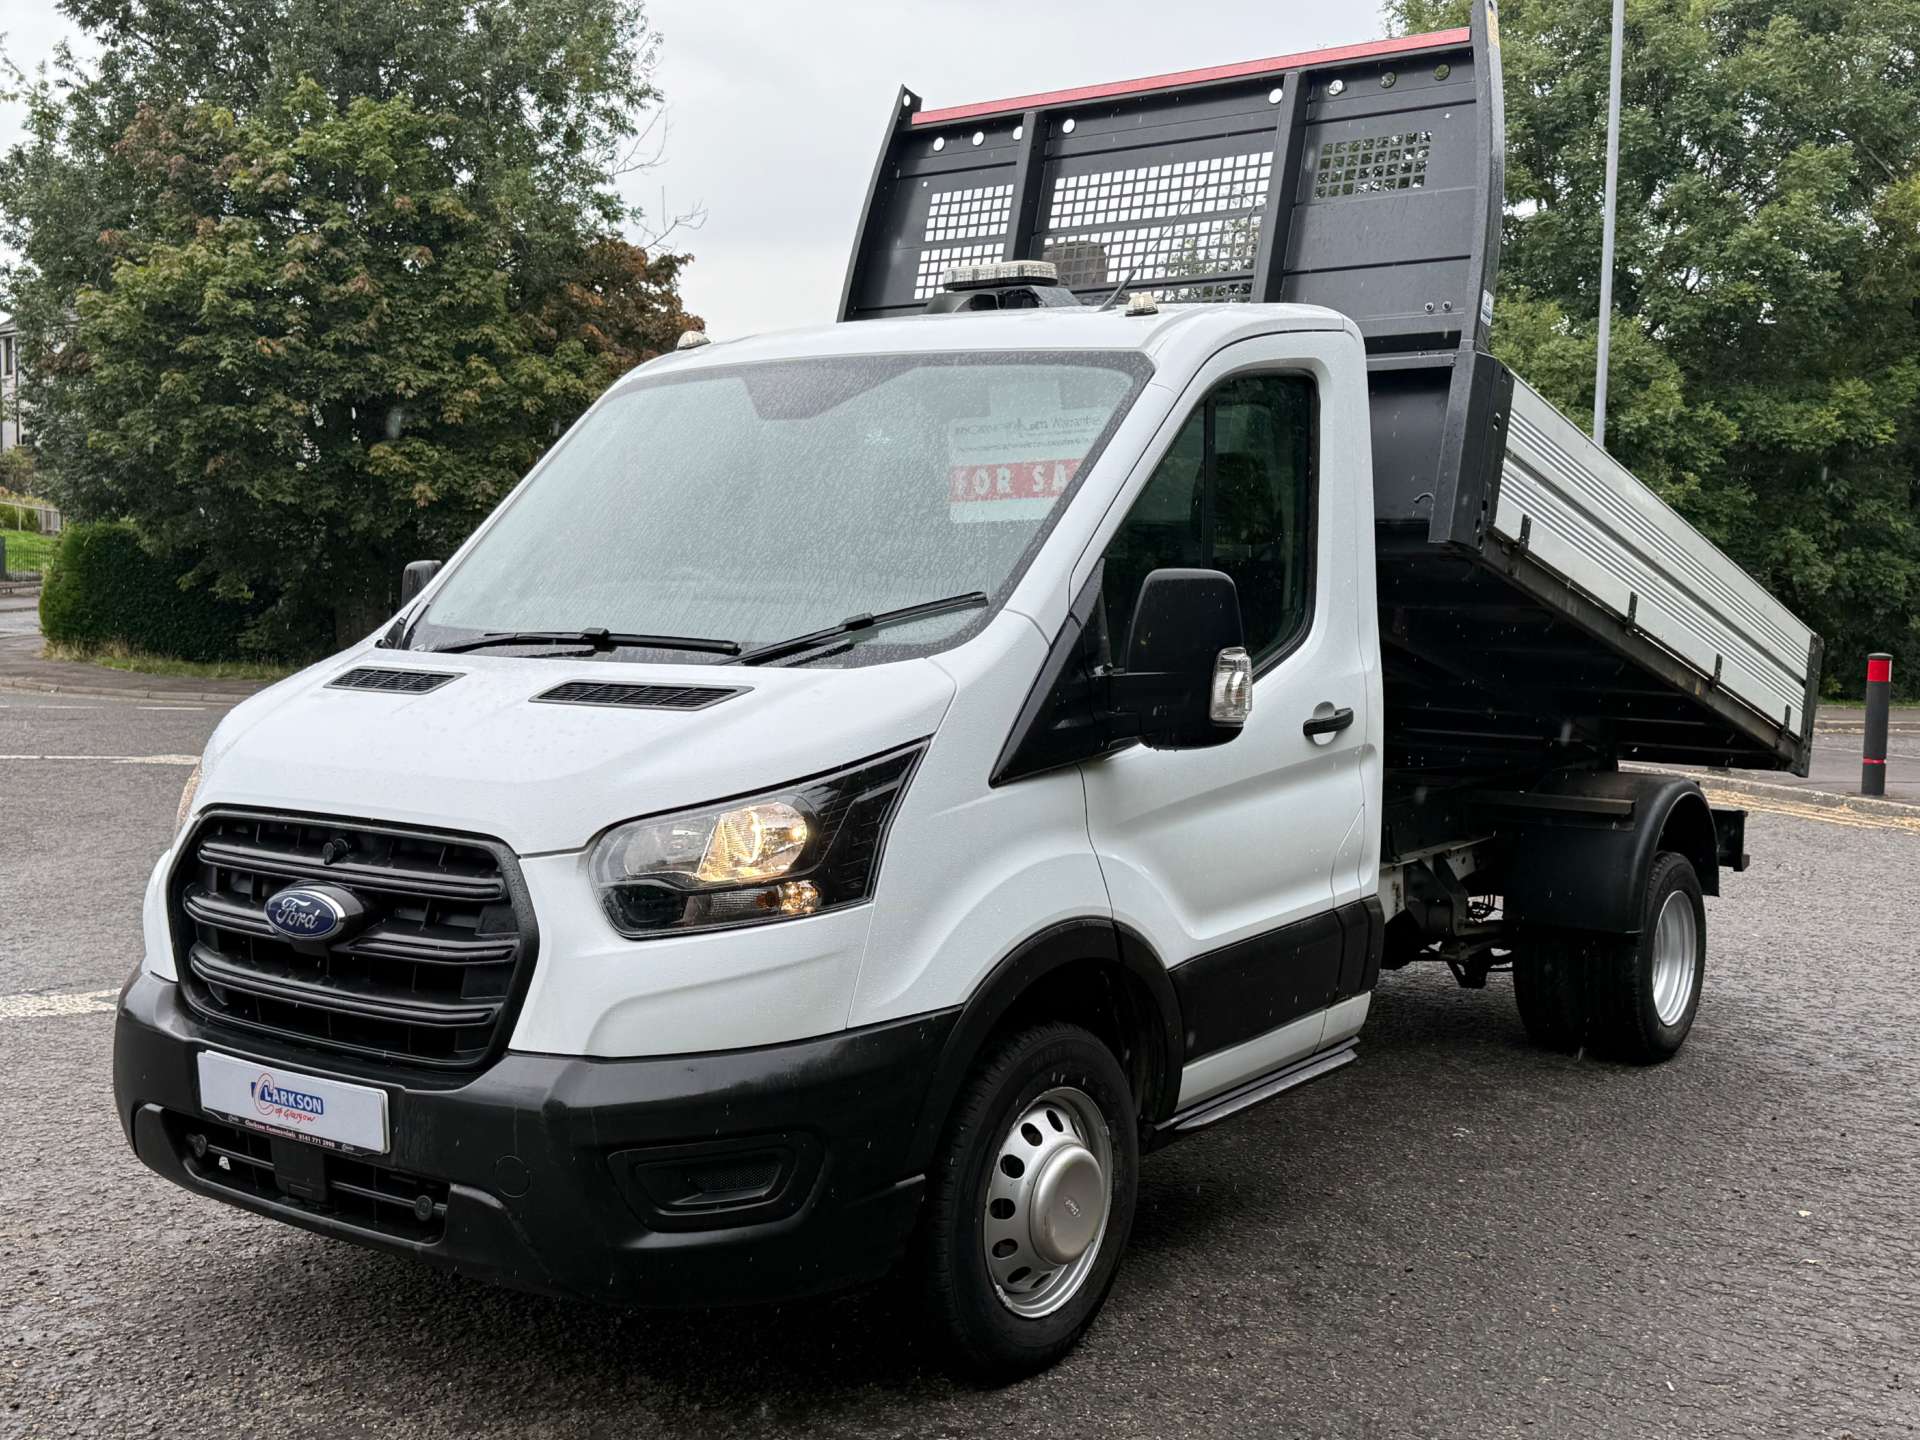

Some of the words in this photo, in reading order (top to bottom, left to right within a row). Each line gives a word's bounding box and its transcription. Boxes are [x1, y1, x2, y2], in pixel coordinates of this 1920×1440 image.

[953, 465, 1011, 496] FOR
[1032, 461, 1079, 494] SA
[276, 897, 320, 929] Ford
[254, 1073, 322, 1115] CLARKSON
[275, 1107, 283, 1117] of
[283, 1108, 316, 1124] Glasgow
